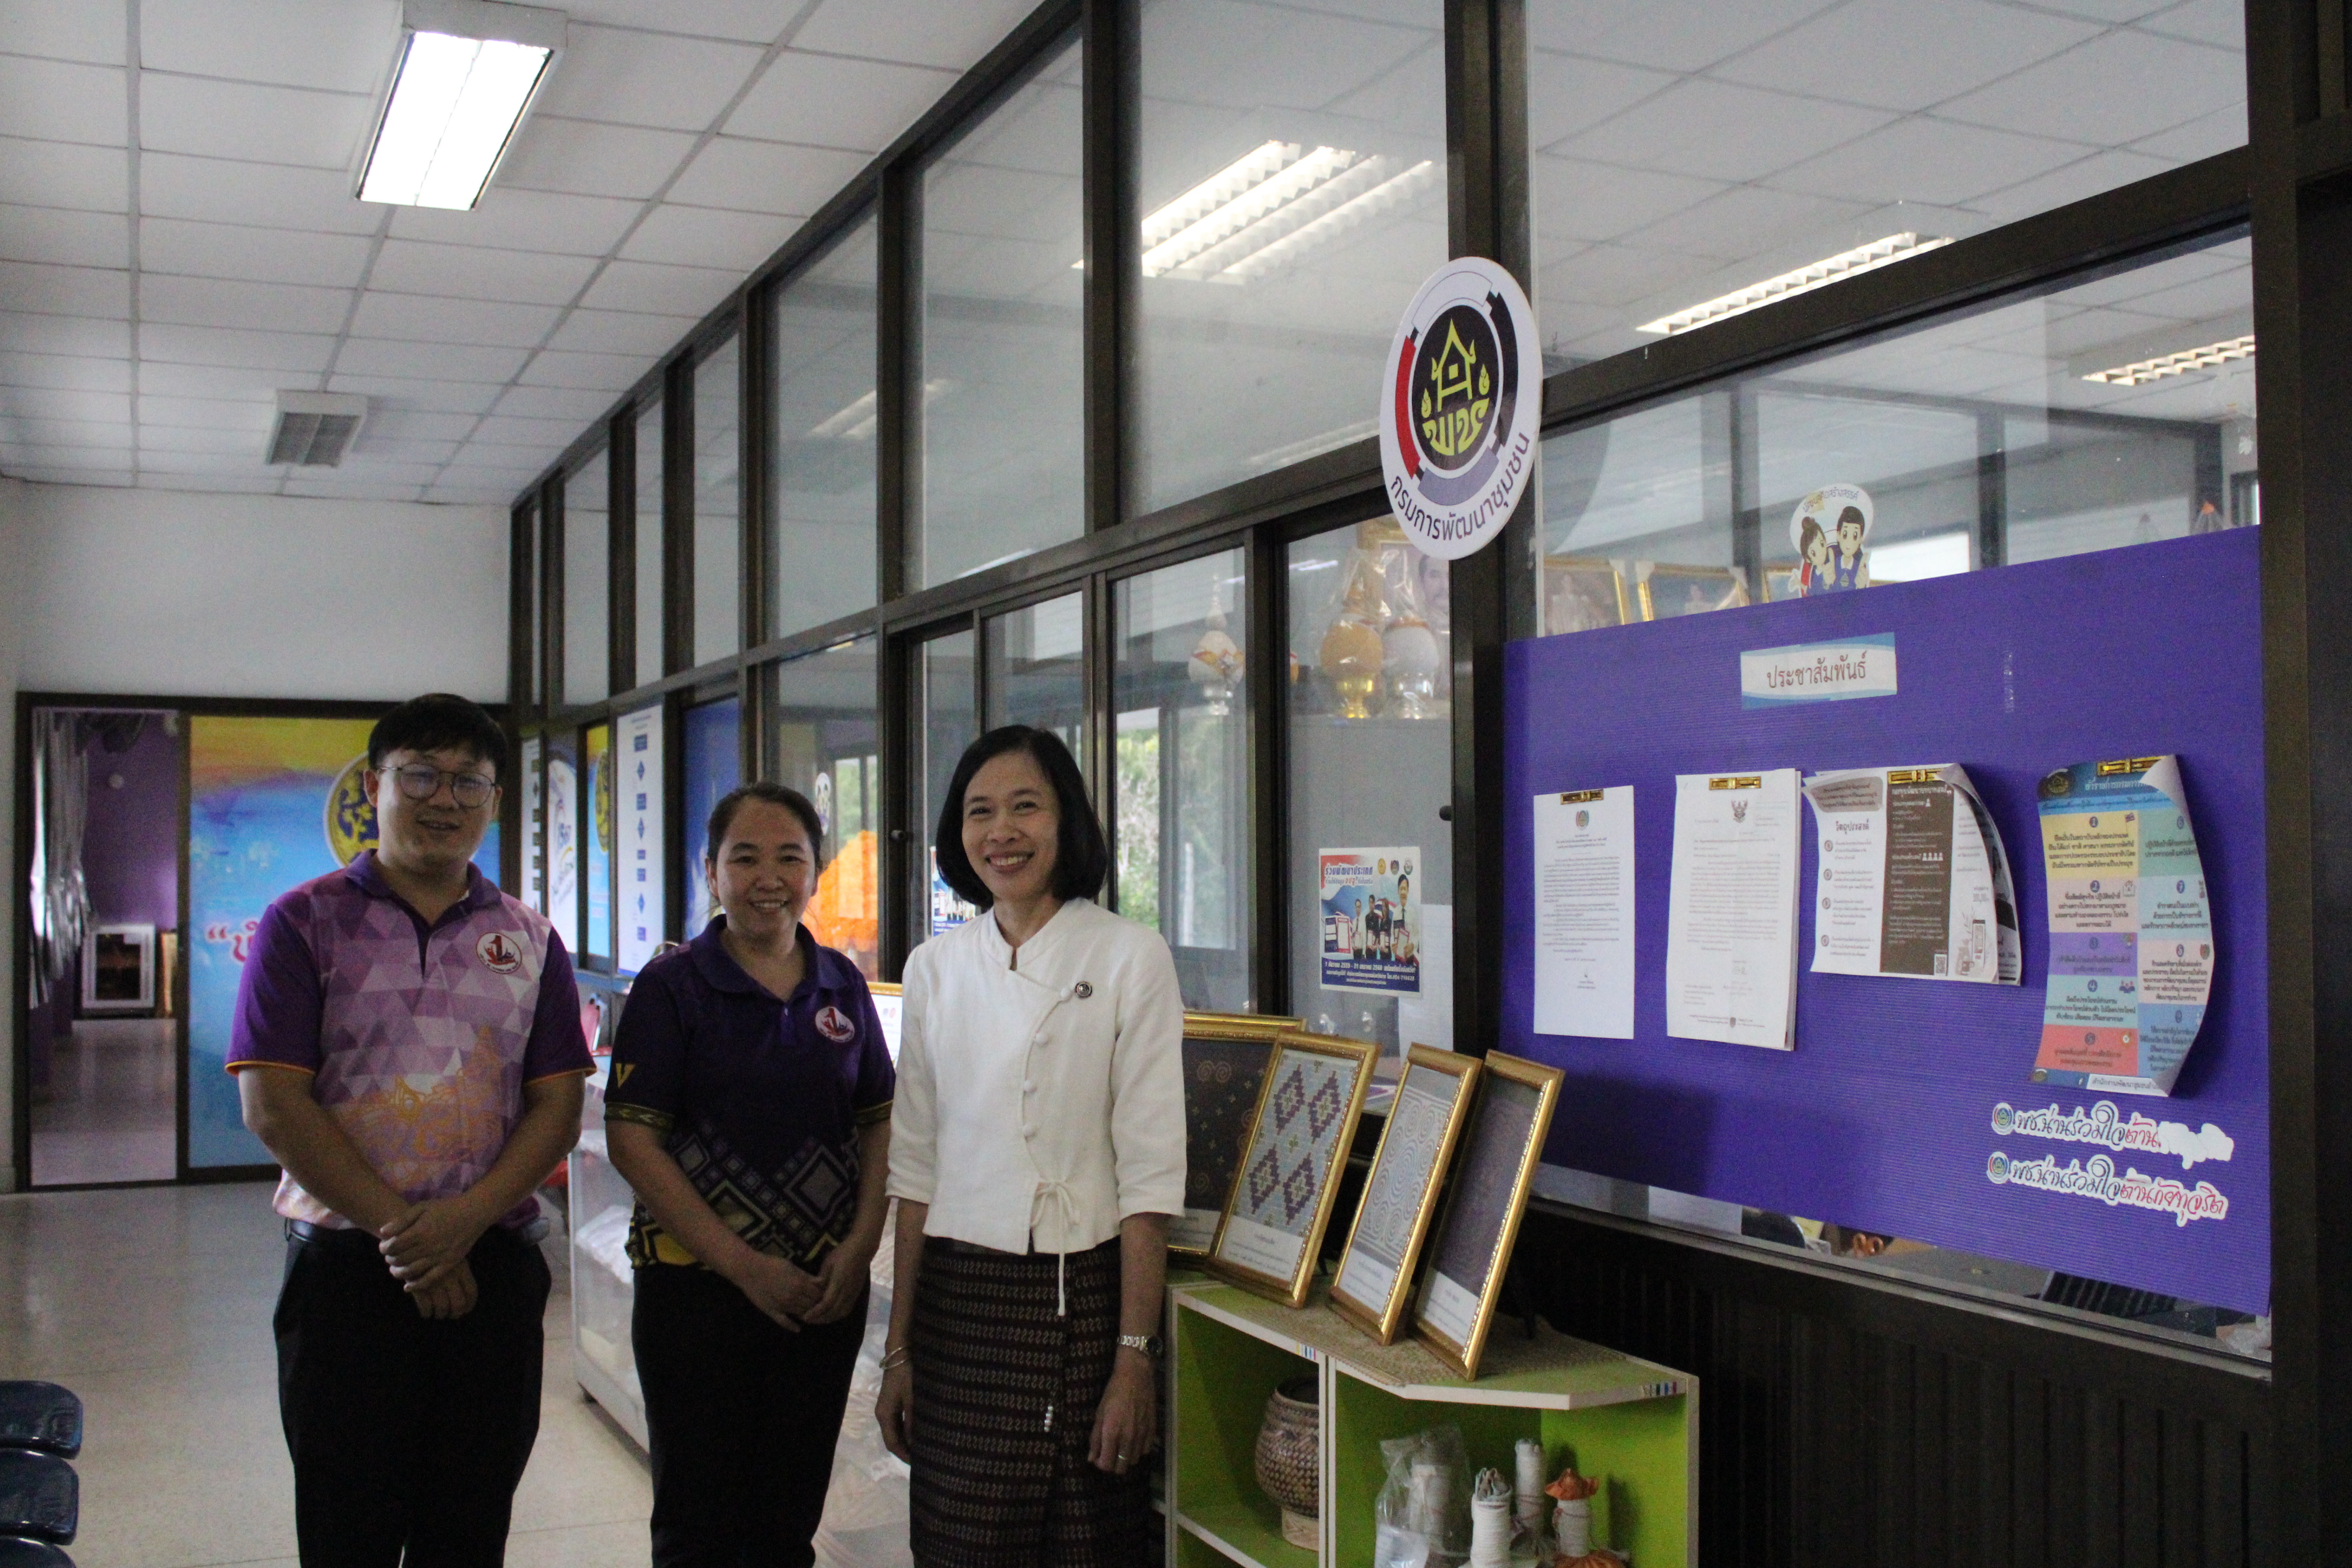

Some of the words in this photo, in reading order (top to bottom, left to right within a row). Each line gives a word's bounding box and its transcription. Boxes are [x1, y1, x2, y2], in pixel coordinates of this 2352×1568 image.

[1391, 432, 1529, 541] กรมการพัฒนาชุมชน
[1766, 650, 1867, 688] ประชาสัมพันธ์
